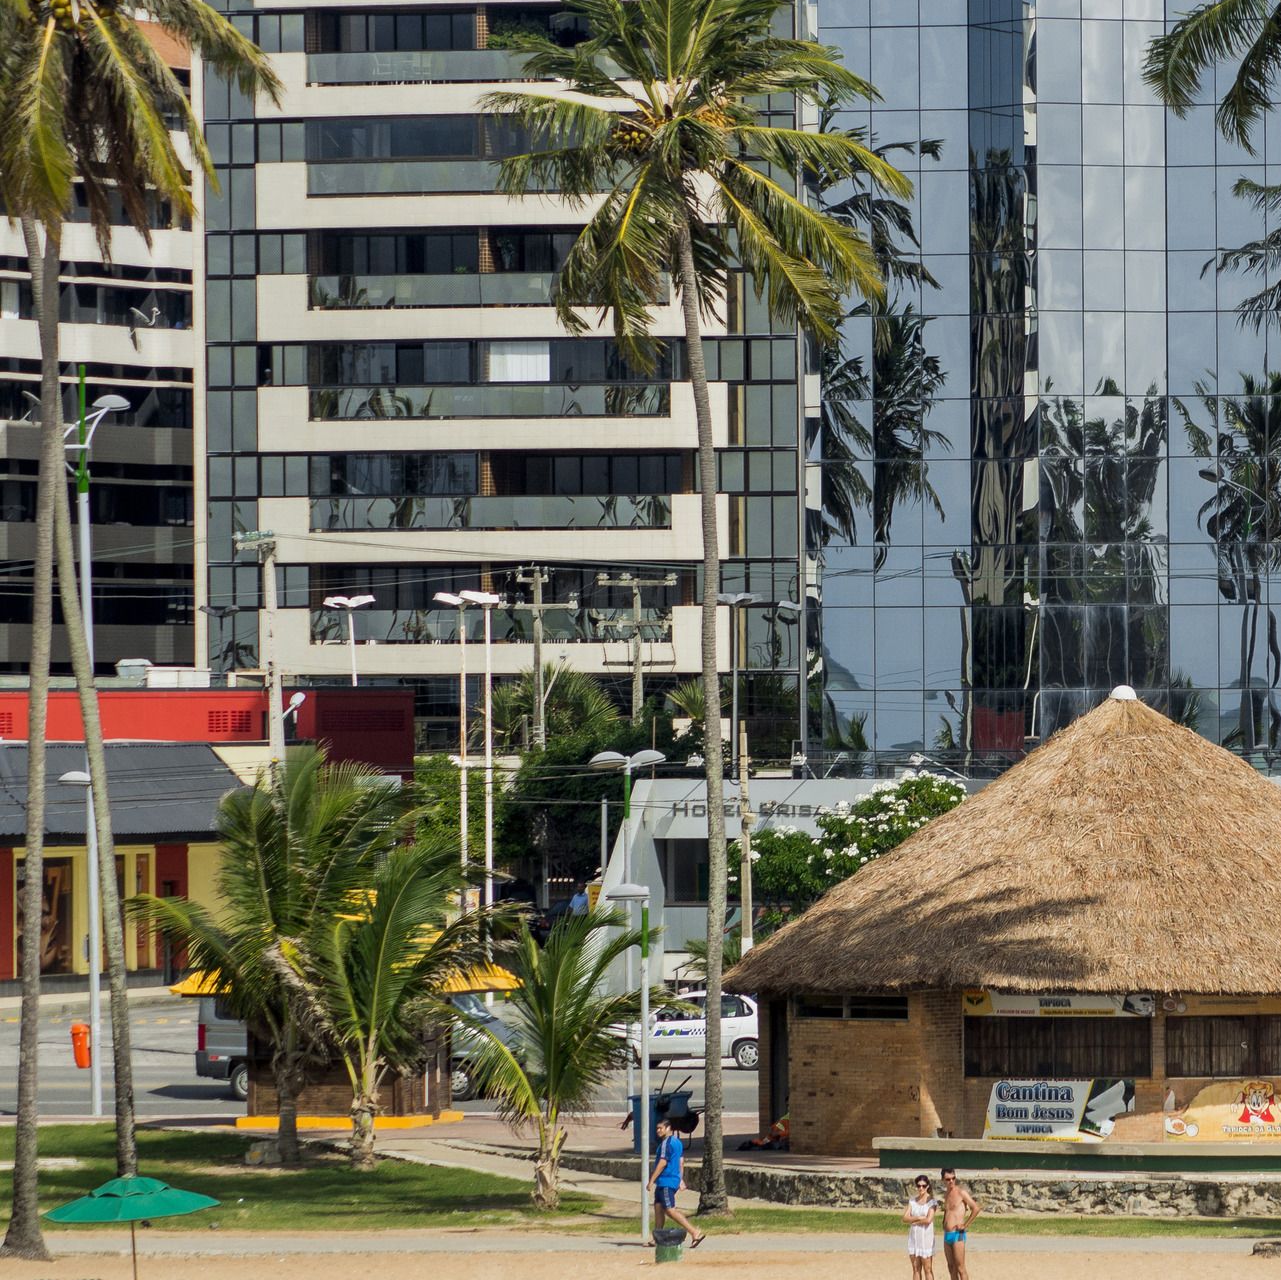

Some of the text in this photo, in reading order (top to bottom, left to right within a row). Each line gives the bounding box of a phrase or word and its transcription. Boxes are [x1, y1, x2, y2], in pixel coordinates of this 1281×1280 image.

[995, 1081, 1075, 1103] Cantina
[995, 1104, 1075, 1121] Bom Jesus
[1014, 1124, 1054, 1134] TAPIOCA
